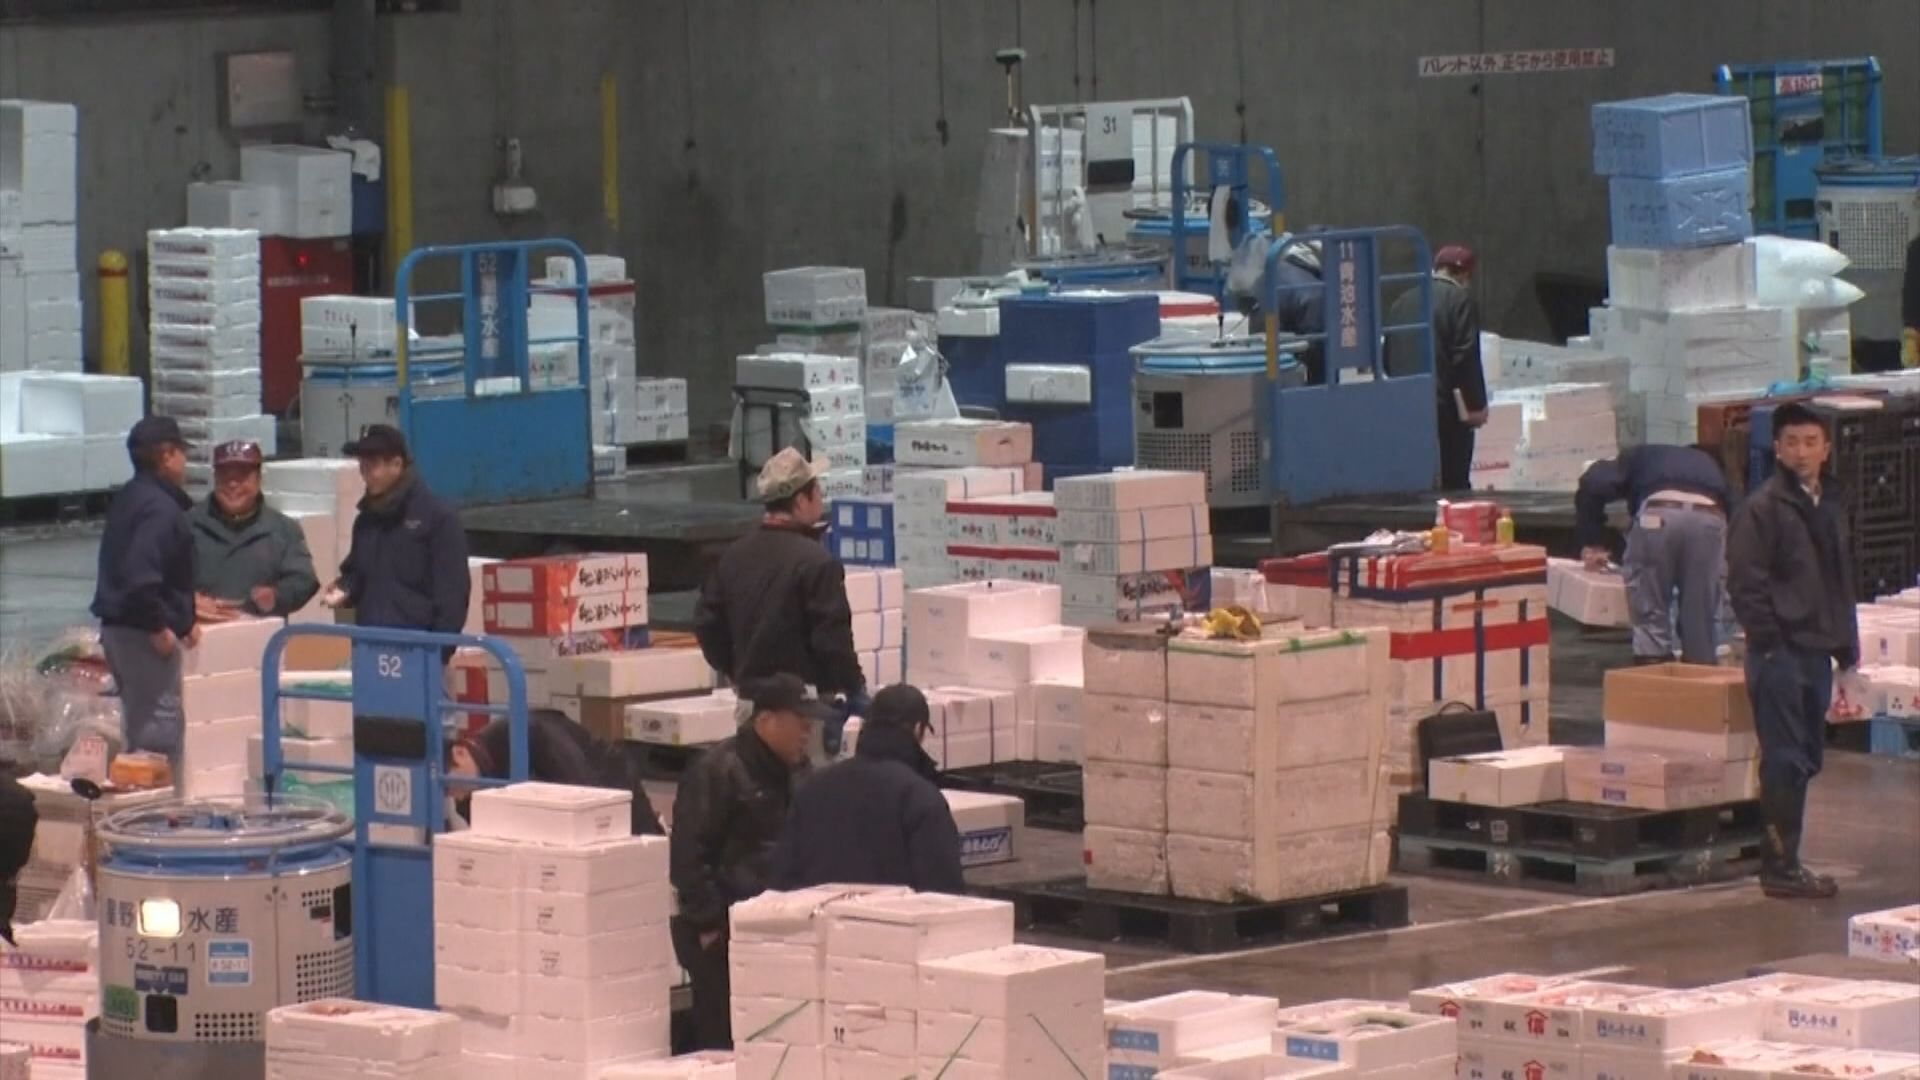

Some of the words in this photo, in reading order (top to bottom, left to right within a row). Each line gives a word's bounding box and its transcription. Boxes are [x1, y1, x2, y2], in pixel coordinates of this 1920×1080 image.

[1424, 57, 1496, 73] パレット以外
[1503, 52, 1608, 71] 正午から使用禁止
[1103, 115, 1117, 135] 31
[1340, 240, 1353, 259] 11
[479, 252, 497, 272] 52
[378, 654, 402, 678] 52
[125, 937, 197, 962] 52-11
